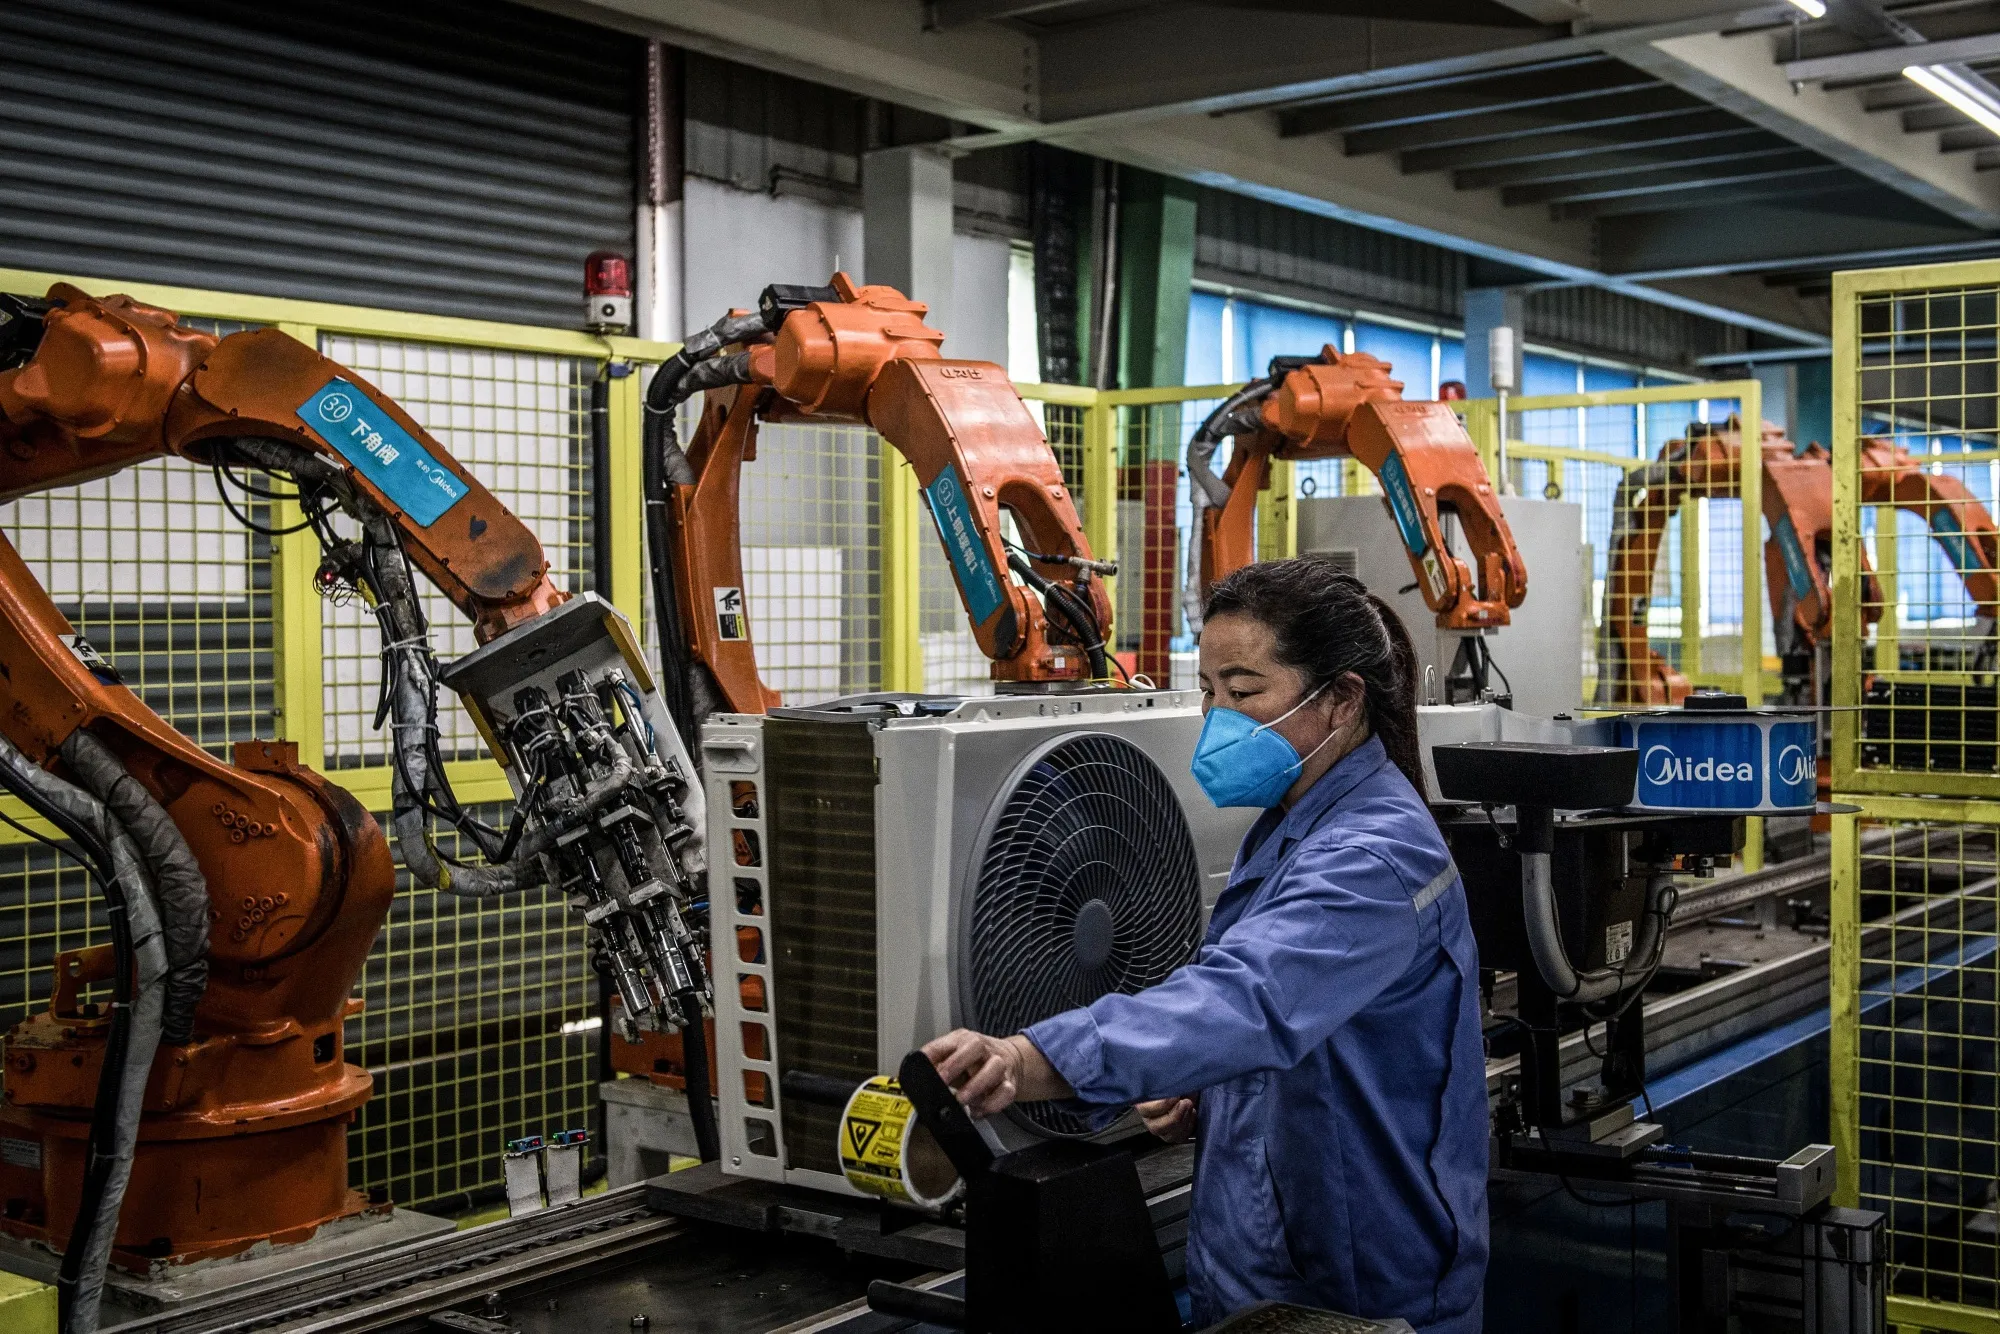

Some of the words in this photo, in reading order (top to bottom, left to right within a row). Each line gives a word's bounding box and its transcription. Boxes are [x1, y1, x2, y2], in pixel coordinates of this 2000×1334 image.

[322, 396, 349, 420] 30
[351, 417, 400, 466] 下角阀
[429, 469, 457, 499] Midea
[938, 481, 953, 504] 31
[1645, 745, 1753, 786] Midea
